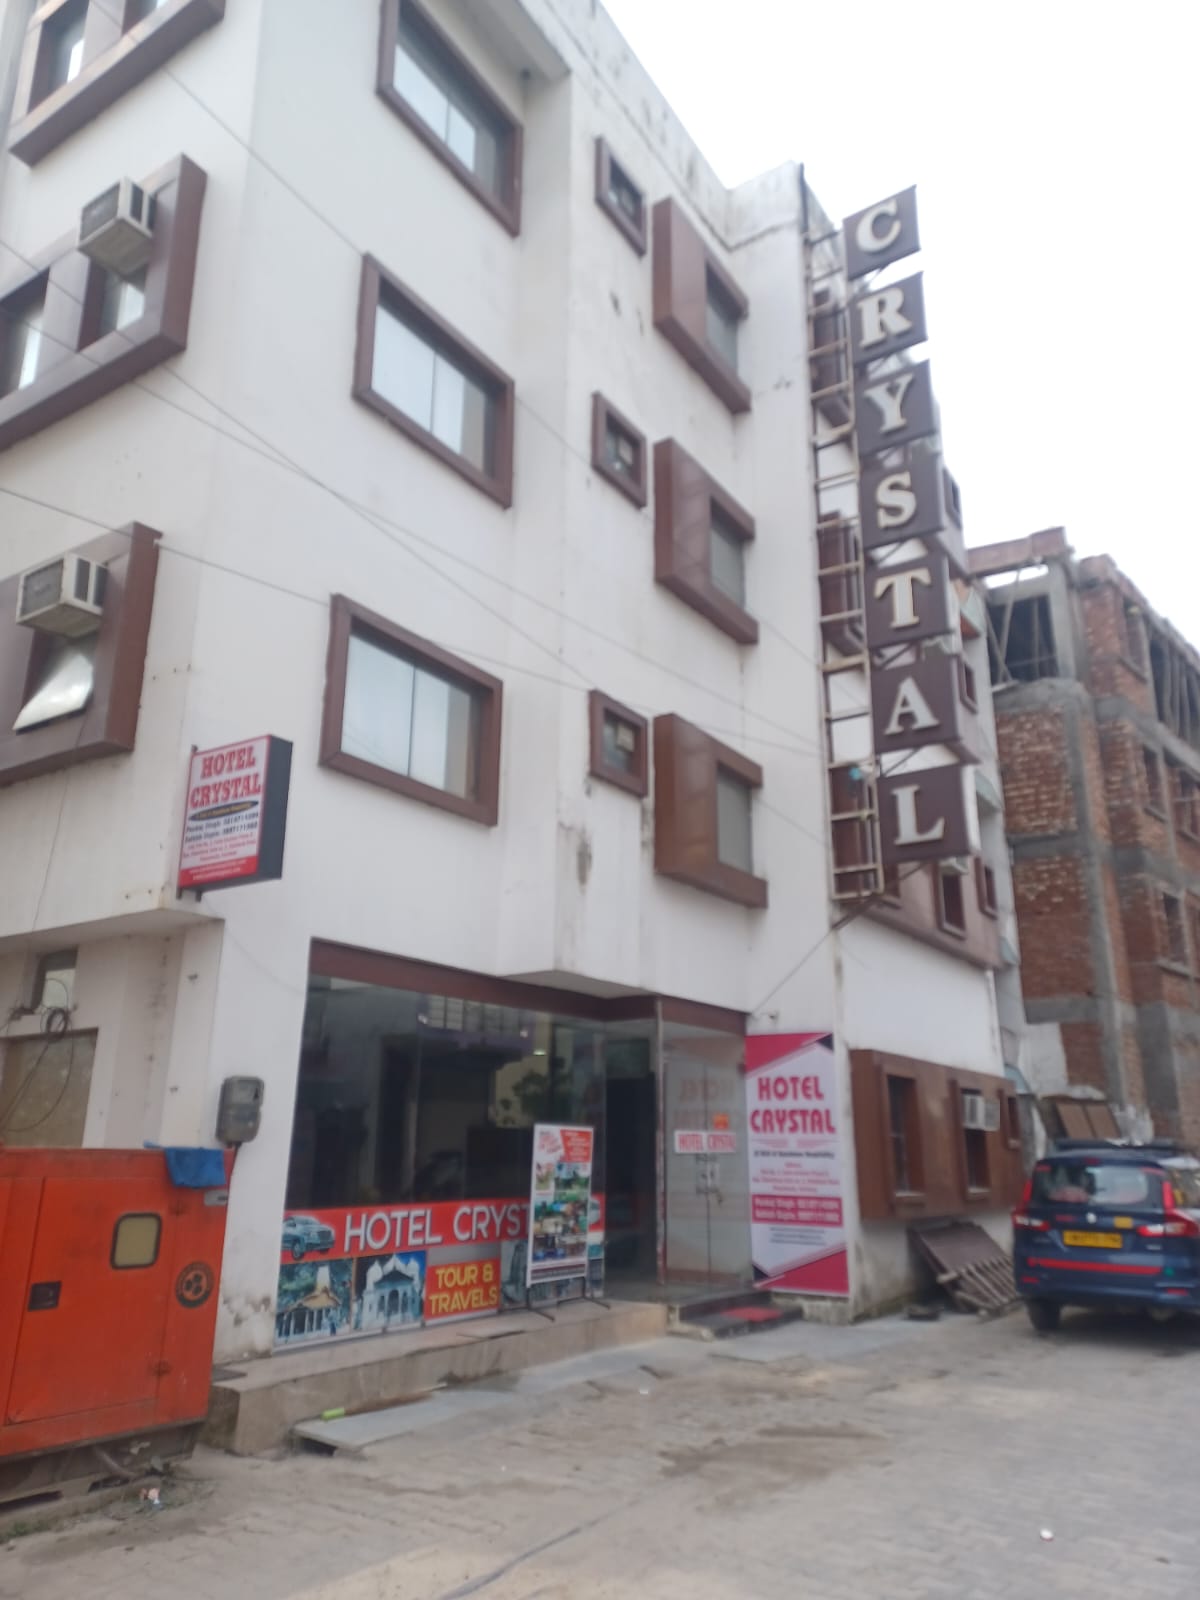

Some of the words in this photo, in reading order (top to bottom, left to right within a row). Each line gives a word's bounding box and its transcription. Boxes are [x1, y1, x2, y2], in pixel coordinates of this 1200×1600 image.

[855, 201, 944, 845] CRYSTAL
[201, 747, 256, 779] HOTEL
[190, 773, 262, 809] CRYSTAL
[757, 1075, 824, 1102] HOTEL
[750, 1107, 836, 1134] CRYSTAL
[344, 1208, 442, 1252] HOTEL
[435, 1264, 478, 1290] TOUR
[482, 1261, 494, 1282] &
[429, 1285, 498, 1315] TRAVELS
